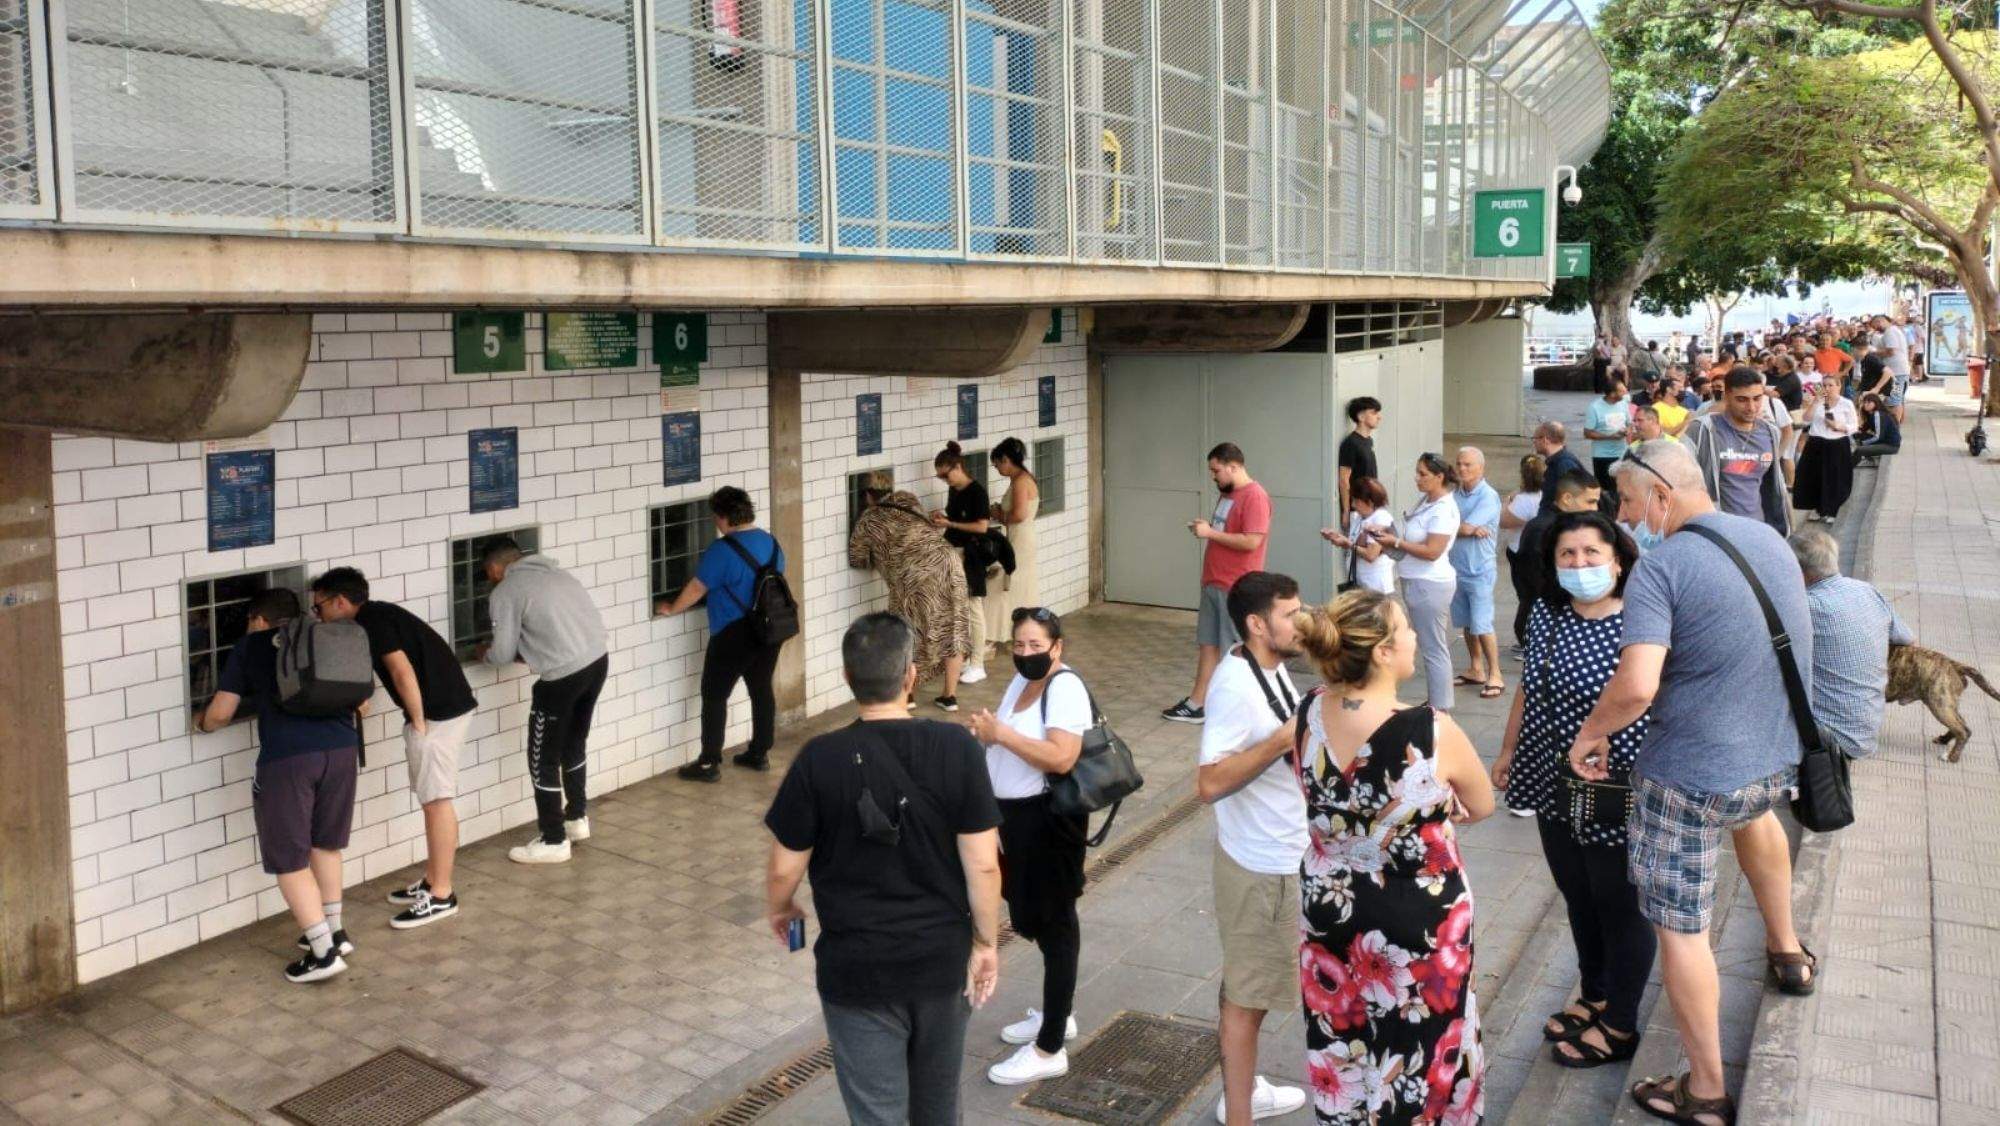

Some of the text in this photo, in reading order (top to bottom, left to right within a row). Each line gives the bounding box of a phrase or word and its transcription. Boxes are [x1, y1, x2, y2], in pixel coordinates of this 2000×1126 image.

[1491, 199, 1529, 210] PUERTA
[1498, 216, 1521, 248] 6
[1567, 257, 1579, 274] 7
[483, 325, 501, 358] 5
[675, 322, 688, 350] 6
